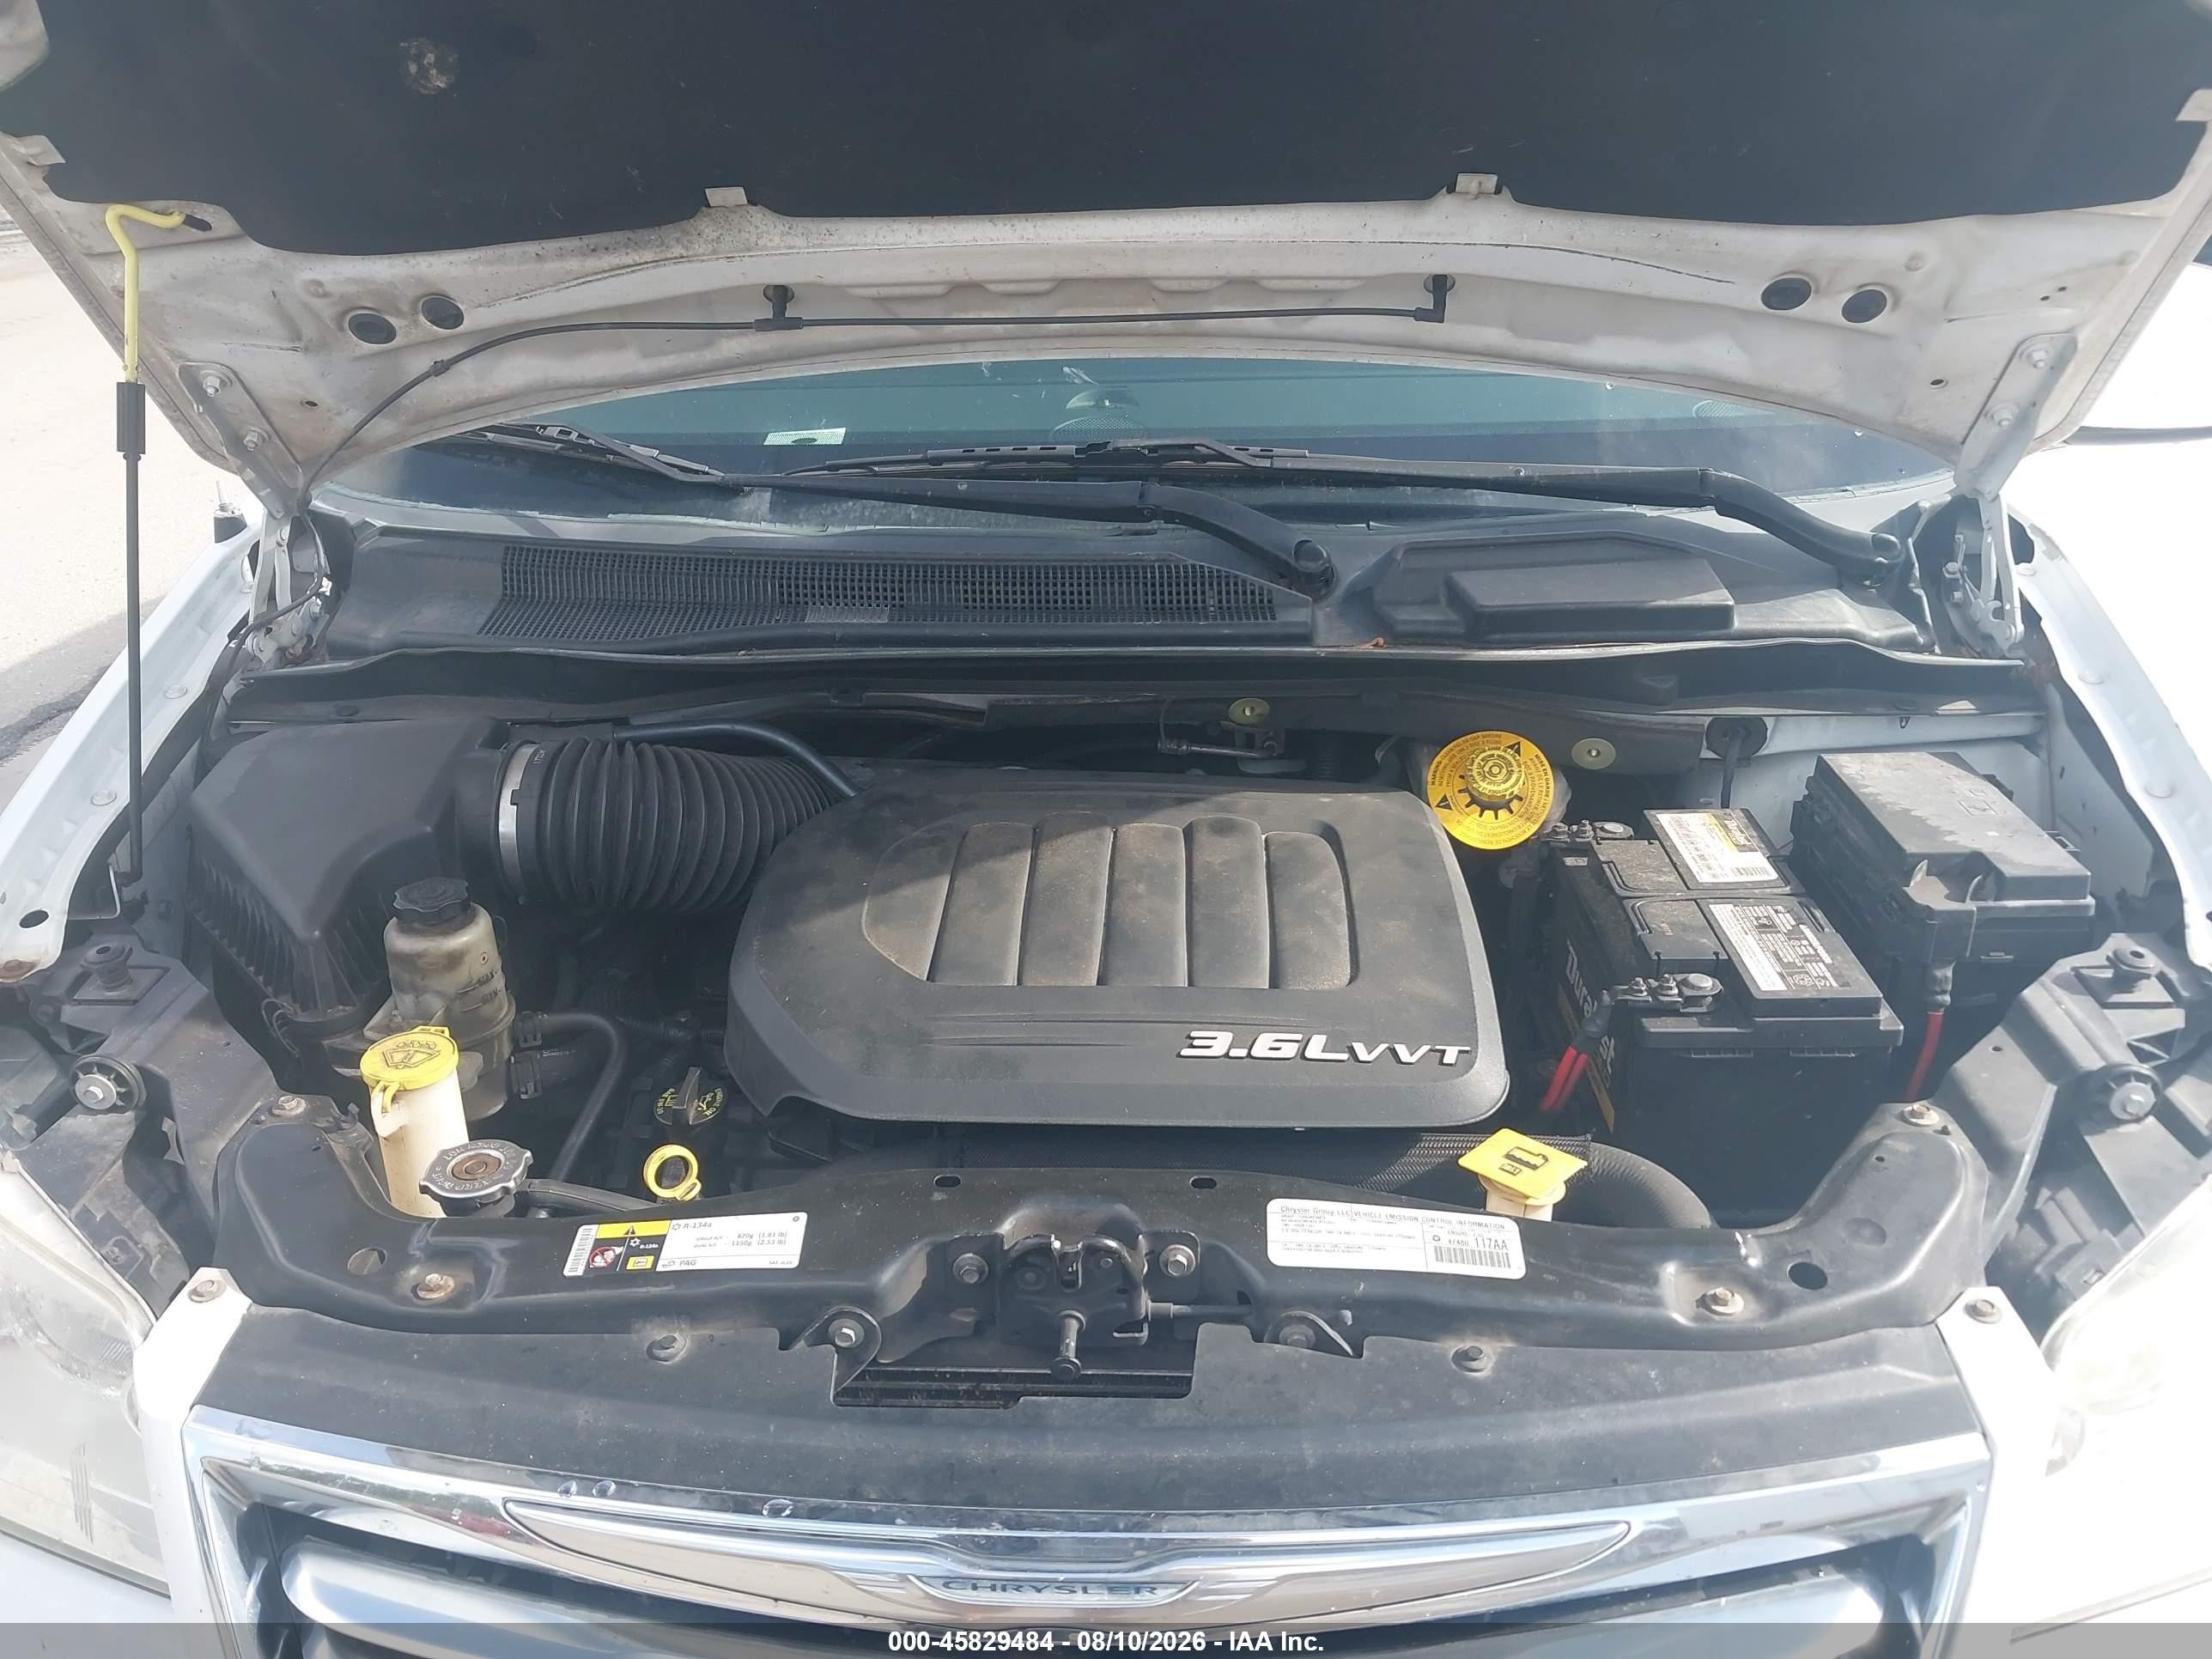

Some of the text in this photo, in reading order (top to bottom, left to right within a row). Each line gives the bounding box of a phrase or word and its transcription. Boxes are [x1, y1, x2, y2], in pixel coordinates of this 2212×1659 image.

[703, 1107, 716, 1115] OIL
[1385, 1212, 1419, 1222] EMISSION
[1421, 1216, 1453, 1225] CONTROL
[1455, 1219, 1505, 1230] INFORMATION
[1474, 1237, 1509, 1251] 117AA
[942, 1580, 1159, 1595] CHRYSLER
